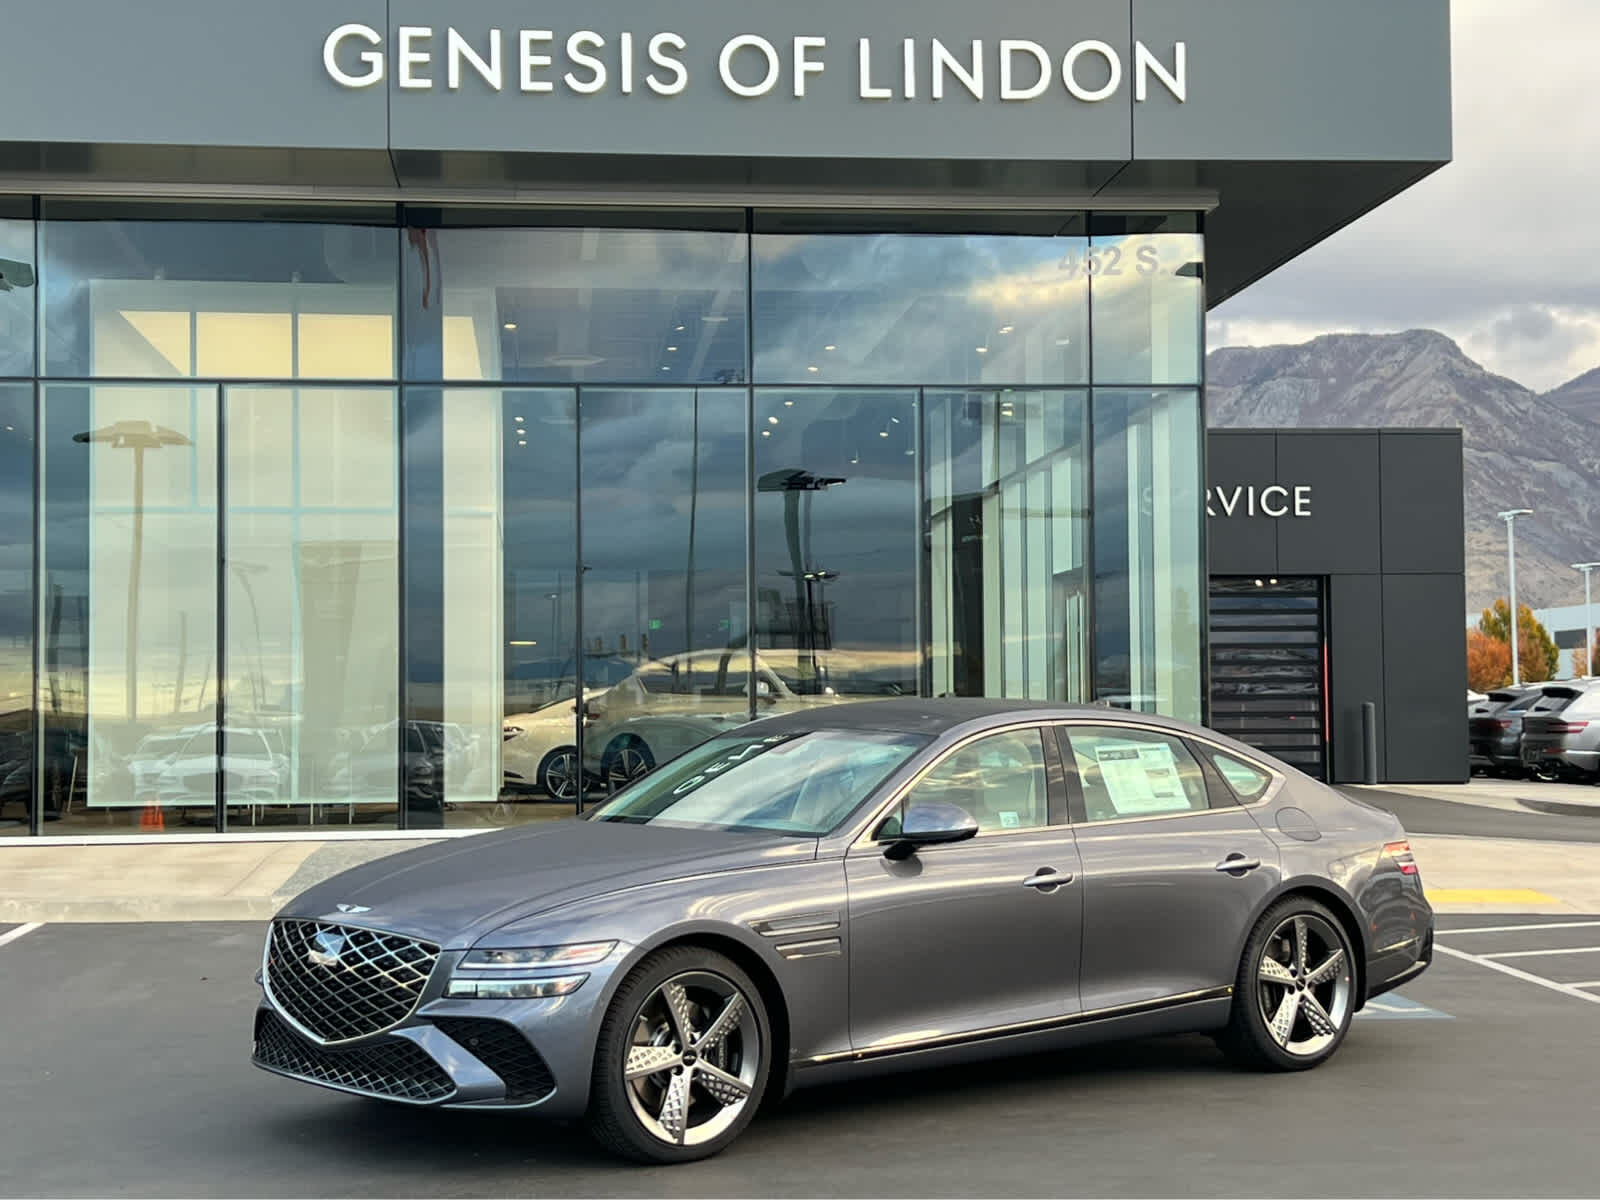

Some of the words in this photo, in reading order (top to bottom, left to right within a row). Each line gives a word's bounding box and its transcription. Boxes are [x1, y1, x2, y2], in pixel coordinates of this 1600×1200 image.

[323, 23, 688, 95] GENESIS
[719, 34, 826, 97] OF
[859, 38, 1186, 102] LINDON
[1057, 245, 1123, 277] 452
